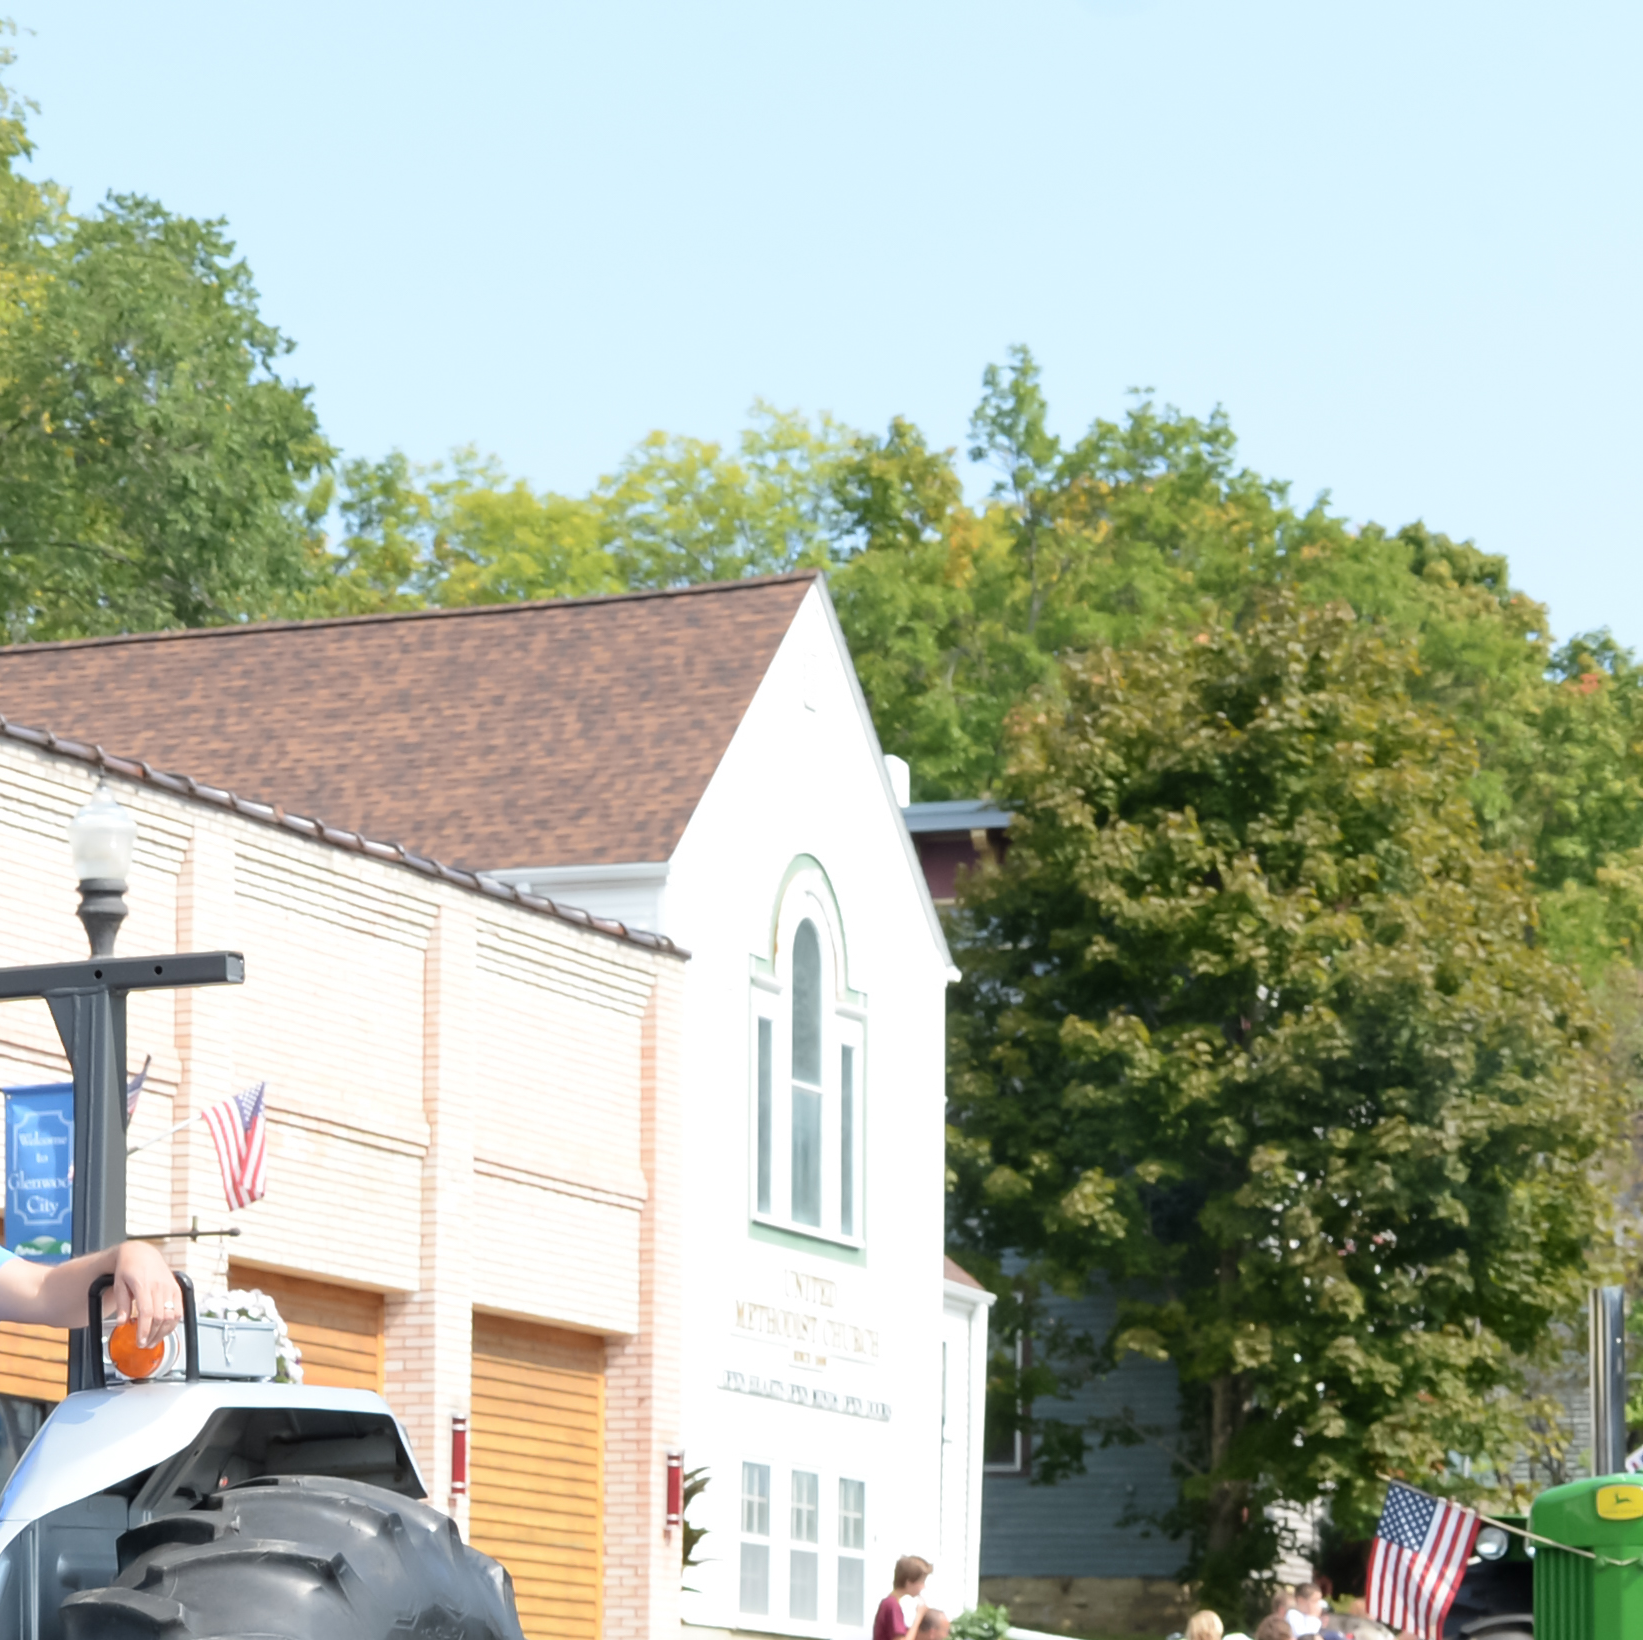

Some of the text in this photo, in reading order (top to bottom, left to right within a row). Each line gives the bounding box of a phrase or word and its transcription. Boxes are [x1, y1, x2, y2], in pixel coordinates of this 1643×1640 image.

[18, 1131, 68, 1146] Welcome
[36, 1153, 49, 1164] to
[26, 1195, 59, 1217] City
[784, 1268, 838, 1308] UNITED
[735, 1299, 880, 1358] METHODIST CHURCH
